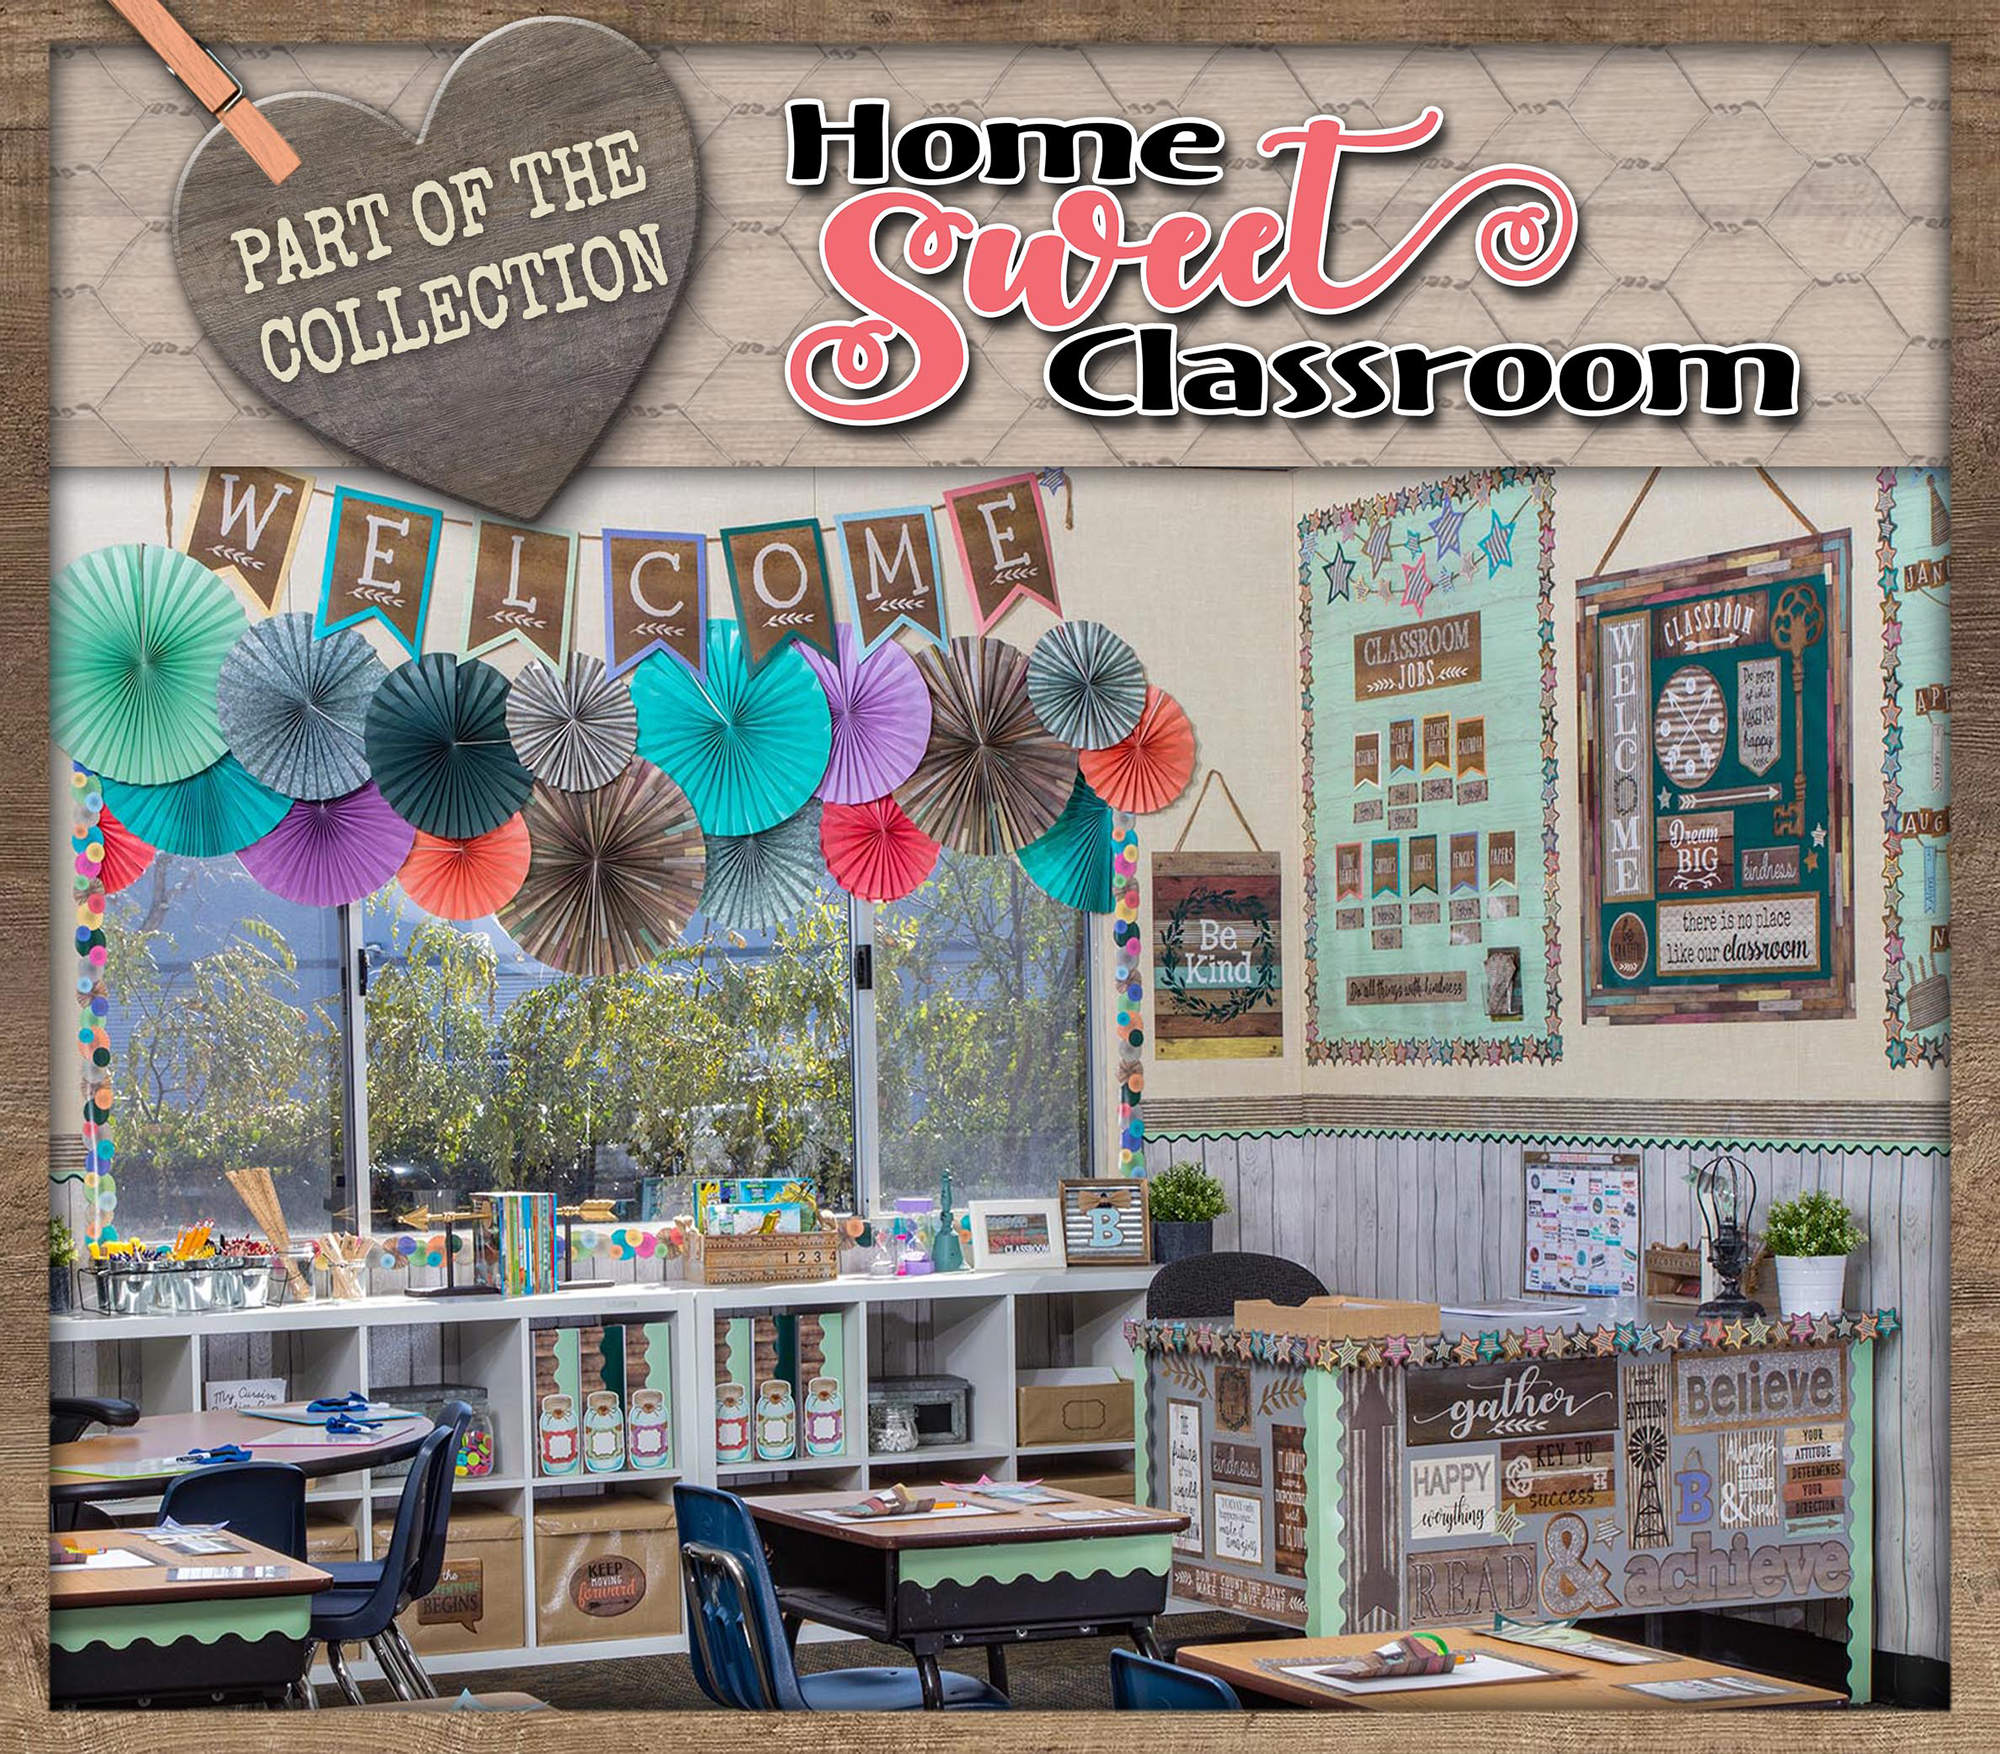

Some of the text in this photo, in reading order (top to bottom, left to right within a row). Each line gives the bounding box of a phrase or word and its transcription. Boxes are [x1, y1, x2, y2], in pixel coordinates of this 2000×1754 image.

[1663, 601, 1756, 648] CLASSROOM
[1363, 619, 1472, 666] CLASSROOM
[1397, 659, 1435, 690] JOBS
[1743, 731, 1774, 756] happy
[1669, 818, 1720, 850] Dream
[1490, 846, 1514, 866] PAPERS
[1677, 846, 1719, 874] BIG
[1743, 852, 1797, 881] kindness
[1200, 918, 1237, 951] Be
[1683, 907, 1791, 934] there is no place
[1666, 944, 1695, 964] like
[1696, 945, 1720, 962] our
[1722, 933, 1810, 962] classroom
[1185, 951, 1252, 984] Kind
[1350, 981, 1362, 1002] Do
[1363, 978, 1376, 998] all
[1377, 978, 1402, 1002] things
[1086, 1206, 1124, 1248] B
[783, 1250, 838, 1264] 1 2 3 4
[1004, 1244, 1050, 1254] CLASSROOM
[213, 1386, 277, 1405] My Cursive
[1413, 1365, 1614, 1439] gather
[1686, 1359, 1835, 1421] Believe
[1802, 1428, 1824, 1442] YOUR
[1212, 1450, 1260, 1480] kindness
[1535, 1441, 1594, 1469] KEY TO
[1795, 1446, 1832, 1460] ATTITUDE
[1413, 1460, 1493, 1498] HAPPY
[1792, 1463, 1842, 1480] DETERMINES
[1530, 1487, 1596, 1509] success
[1675, 1470, 1714, 1526] B
[1720, 1482, 1750, 1524] &
[1802, 1483, 1824, 1497] YOUR
[1413, 1494, 1496, 1533] everything
[1795, 1500, 1837, 1515] DIRECTION
[441, 1569, 459, 1581] the
[588, 1561, 623, 1578] KEEP
[1411, 1511, 1851, 1621] READ & achieve
[578, 1575, 636, 1609] forward
[590, 1575, 623, 1587] MOVING
[1195, 1570, 1287, 1601] DON'T COUNT THE DAYS
[423, 1594, 479, 1615] BEGINS
[1196, 1582, 1217, 1597] MAKE
[1220, 1586, 1235, 1601] THE
[1238, 1591, 1258, 1608] DAYS
[1261, 1597, 1286, 1613] COUNT
